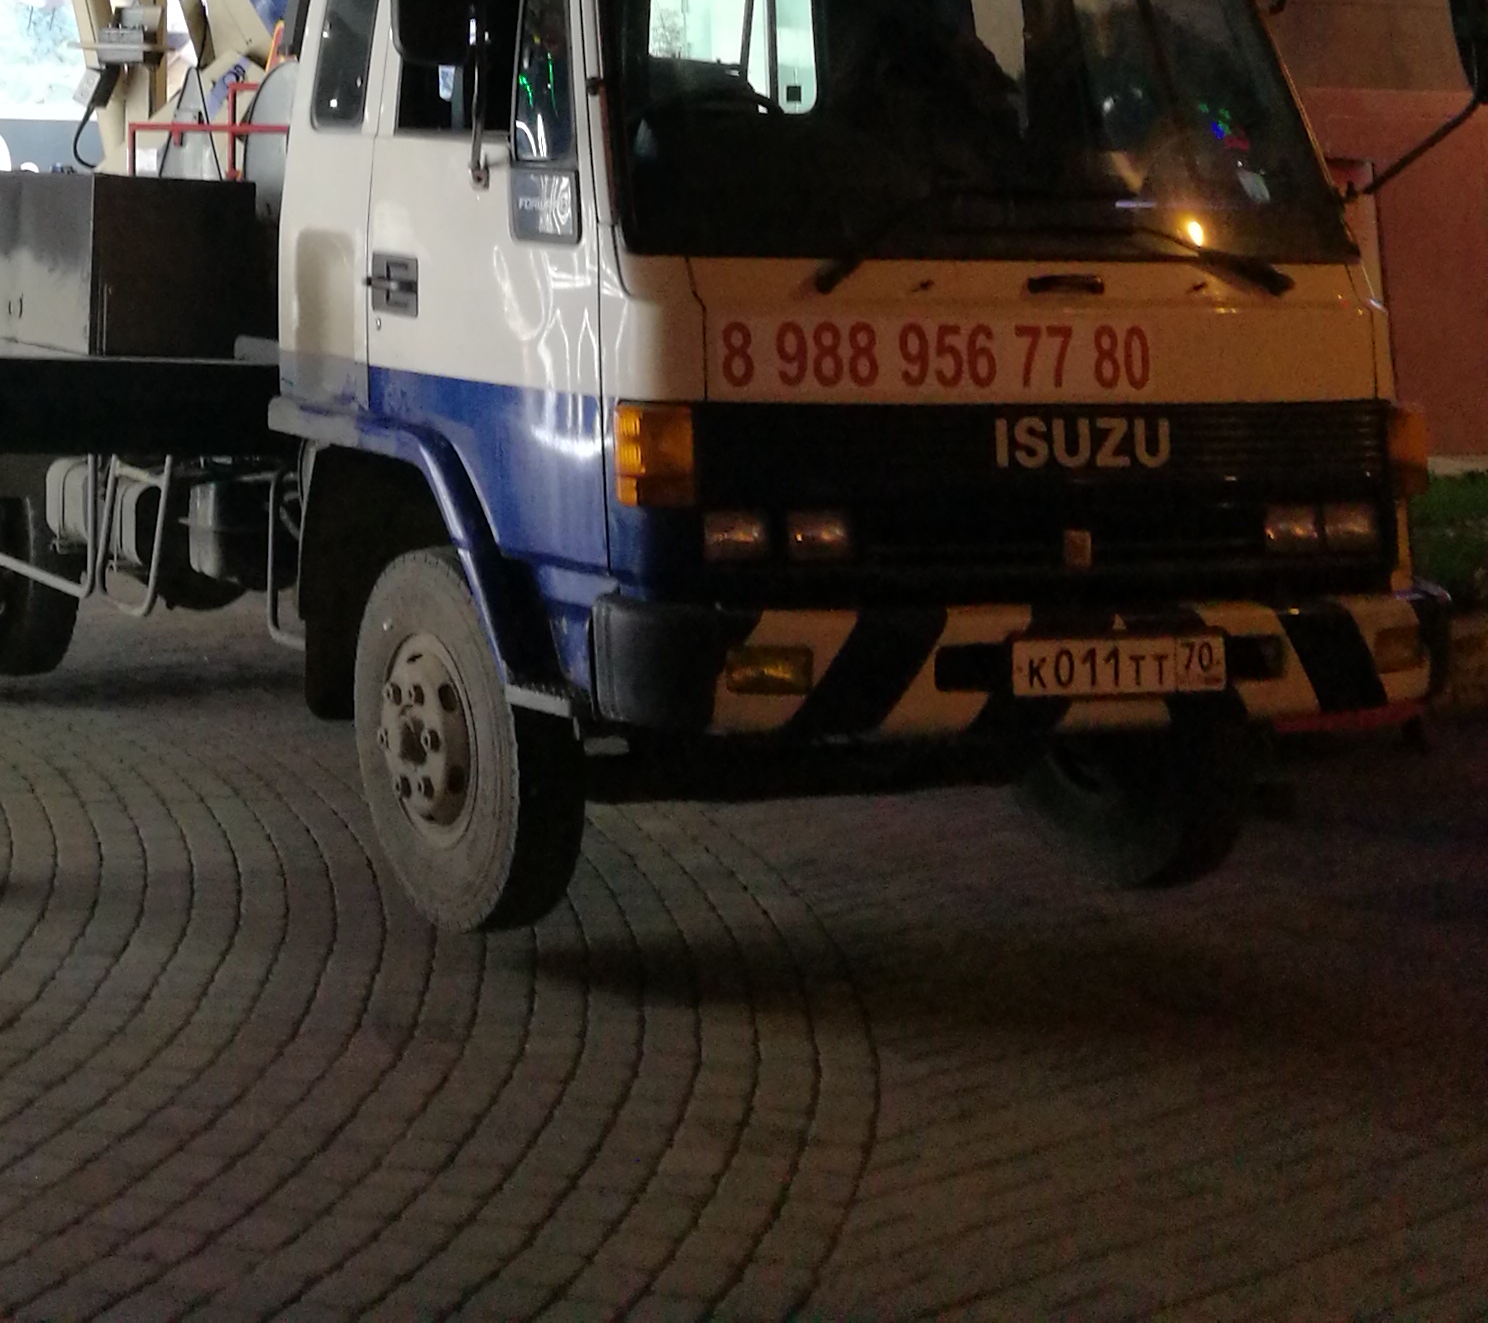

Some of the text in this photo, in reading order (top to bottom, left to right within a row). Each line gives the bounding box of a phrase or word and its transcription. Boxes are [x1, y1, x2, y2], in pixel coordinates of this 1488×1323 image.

[721, 321, 1151, 391] 8 988 956 77 80
[994, 416, 1171, 469] ISUZU
[1179, 641, 1214, 673] 70
